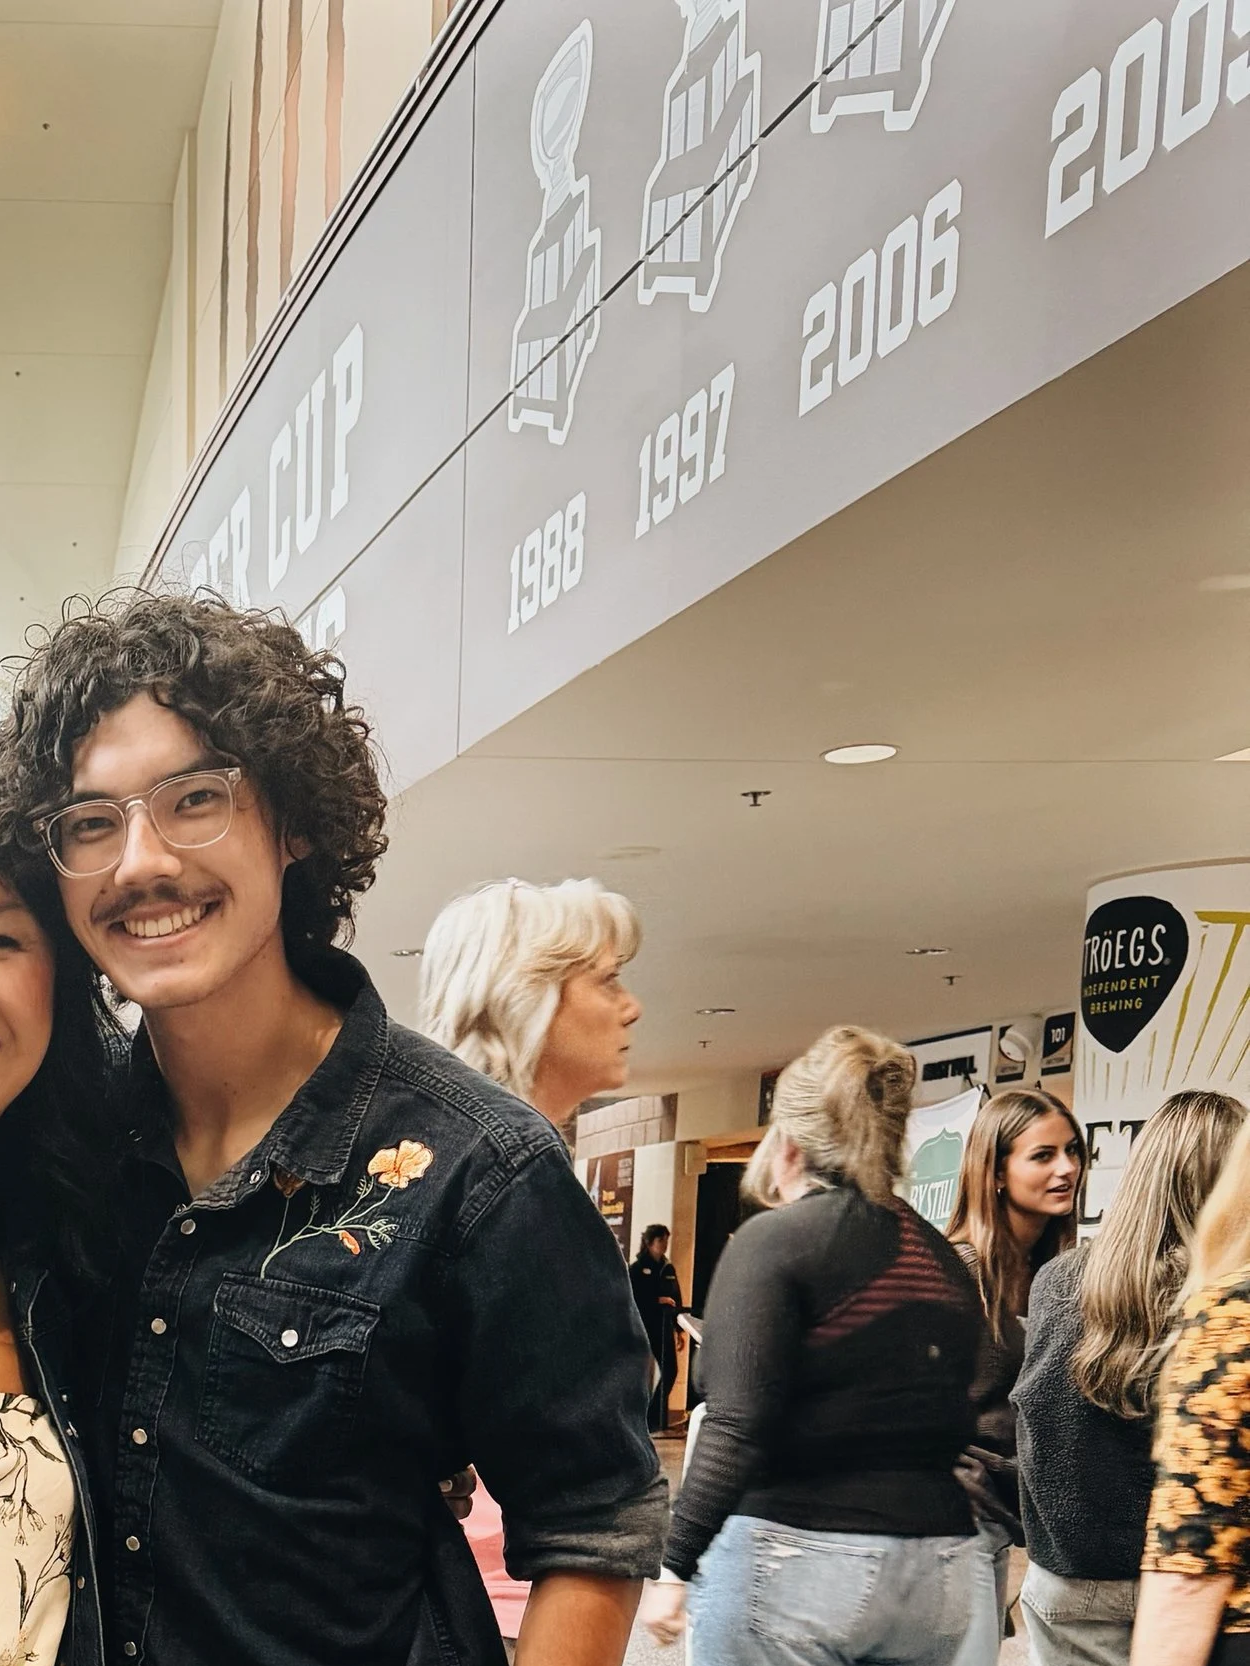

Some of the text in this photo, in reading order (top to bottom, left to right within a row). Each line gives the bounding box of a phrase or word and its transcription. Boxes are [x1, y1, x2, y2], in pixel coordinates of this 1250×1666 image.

[799, 178, 962, 417] 2006
[268, 322, 364, 592] CUP
[635, 362, 735, 540] 1997
[508, 491, 586, 635] 1988
[1051, 1027, 1066, 1043] 101
[1090, 998, 1143, 1015] BREWING
